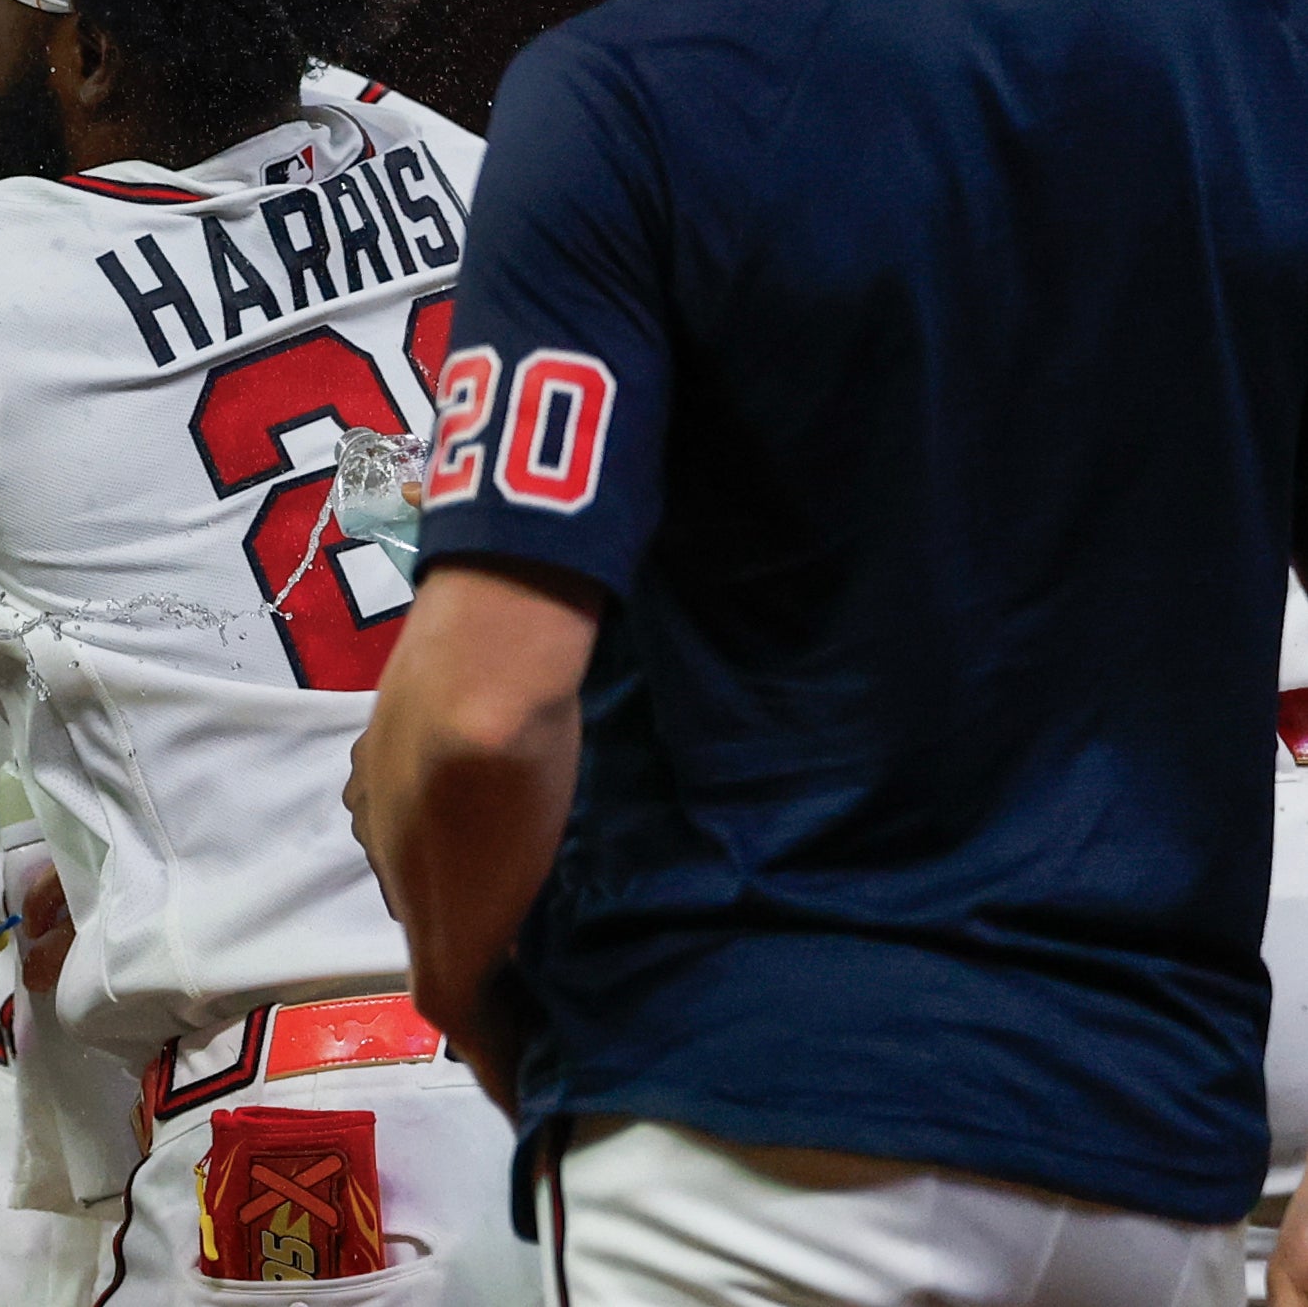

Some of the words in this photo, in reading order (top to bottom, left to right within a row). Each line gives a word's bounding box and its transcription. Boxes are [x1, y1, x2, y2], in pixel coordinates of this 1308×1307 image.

[96, 145, 460, 367] HARRIS
[188, 284, 458, 692] 2
[421, 343, 618, 516] 20
